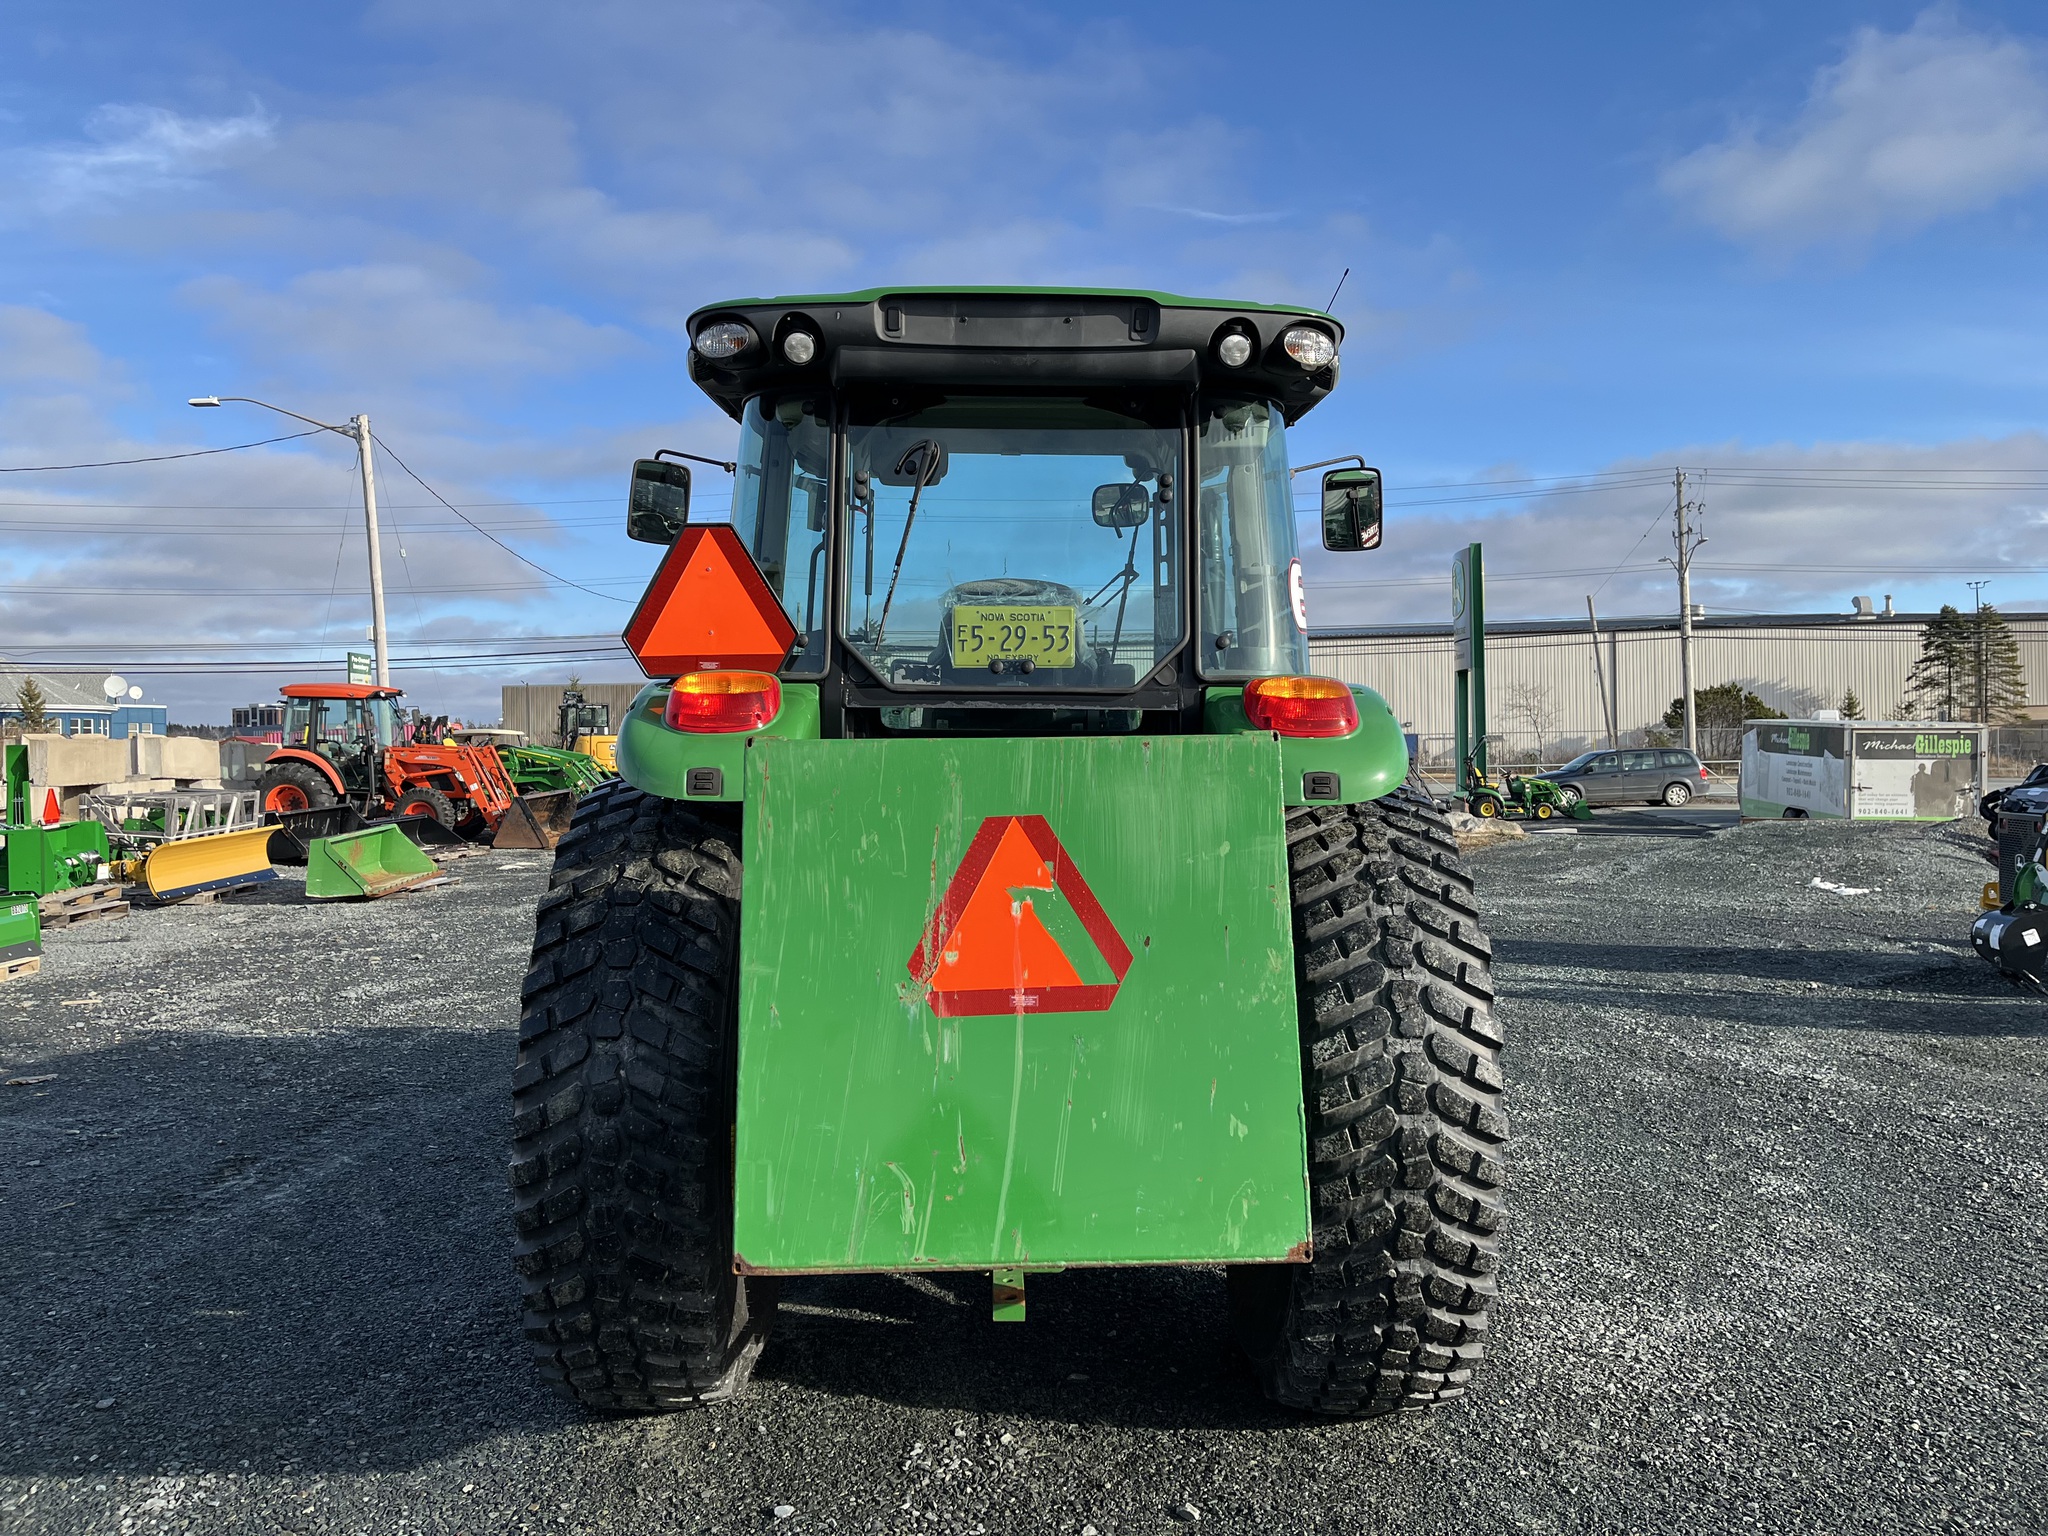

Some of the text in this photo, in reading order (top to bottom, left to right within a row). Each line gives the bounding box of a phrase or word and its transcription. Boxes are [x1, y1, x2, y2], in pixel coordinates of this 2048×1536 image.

[981, 613, 1045, 622] NOVA SCOTIA
[971, 625, 1070, 652] 5-29-53
[1863, 734, 1972, 758] Michael Gillespie
